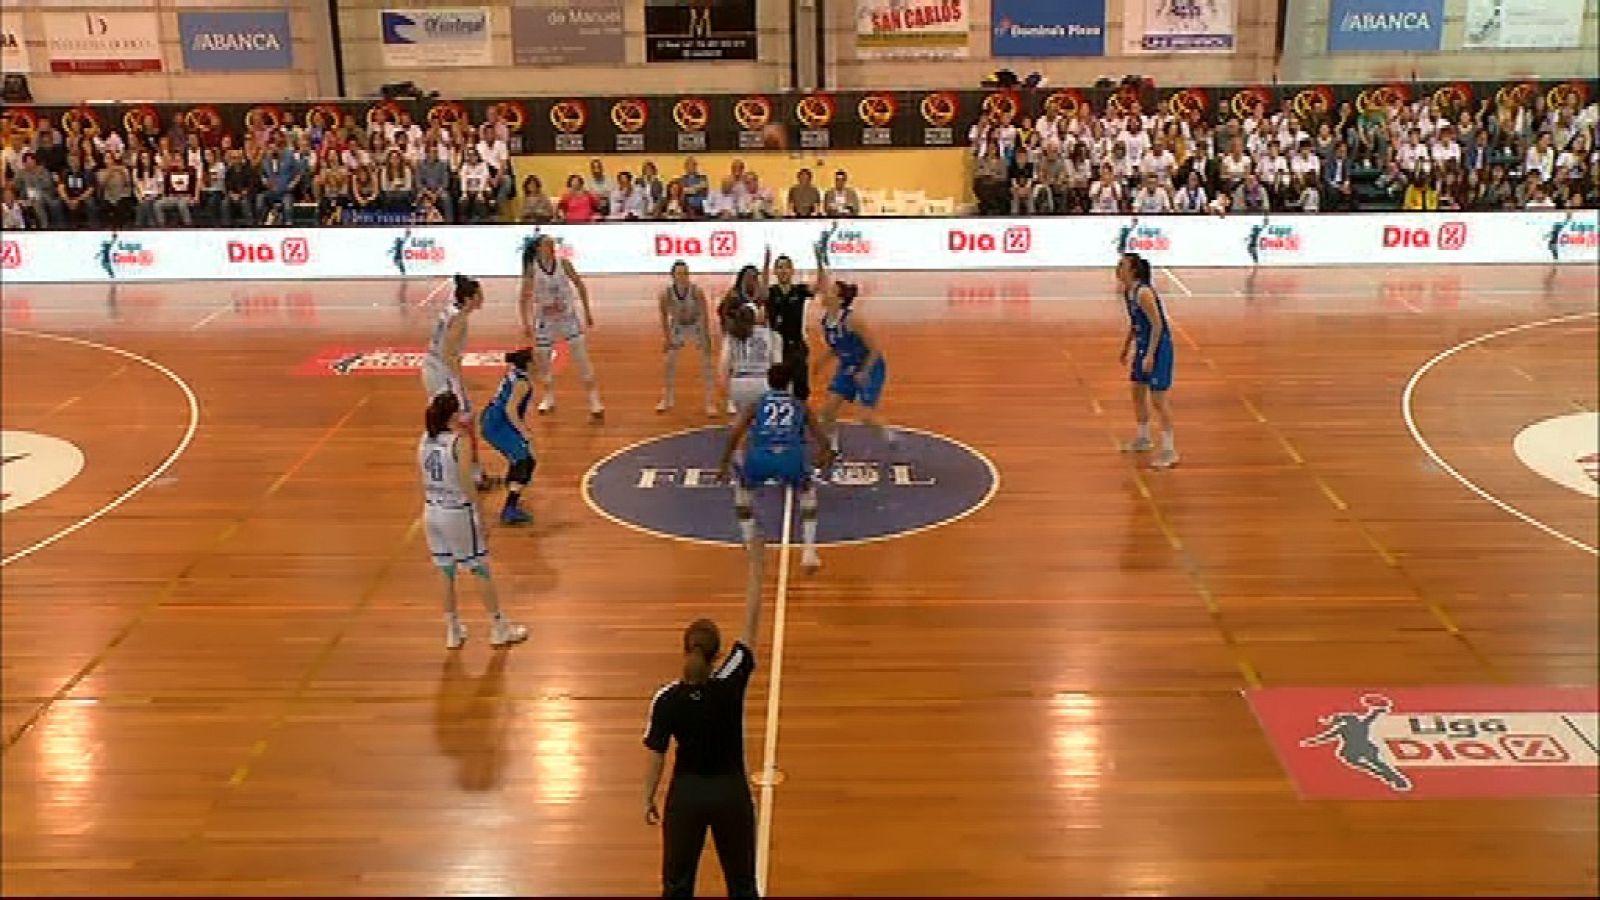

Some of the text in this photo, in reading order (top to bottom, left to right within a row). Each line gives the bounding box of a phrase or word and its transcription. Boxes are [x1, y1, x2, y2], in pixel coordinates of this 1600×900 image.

[872, 0, 962, 30] SAN CARLOS
[763, 401, 795, 428] 22
[634, 462, 937, 488] FEOL
[1408, 715, 1508, 738] Liga
